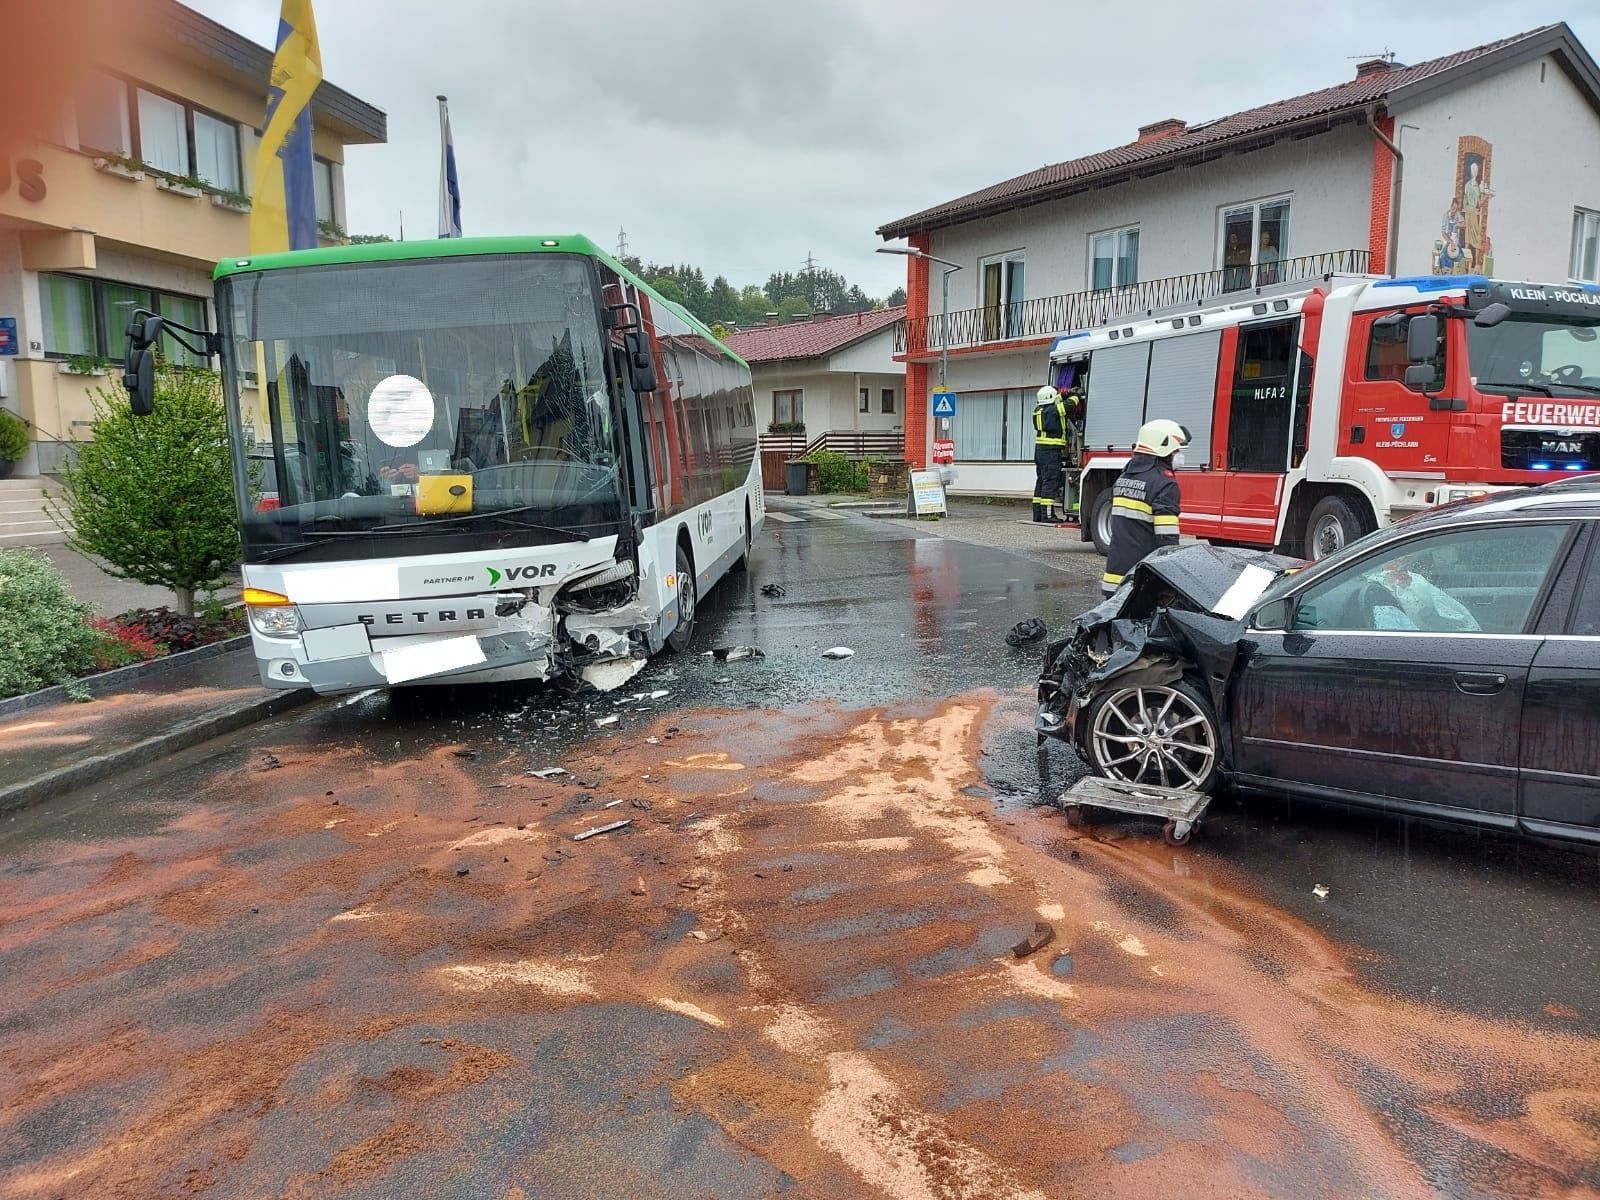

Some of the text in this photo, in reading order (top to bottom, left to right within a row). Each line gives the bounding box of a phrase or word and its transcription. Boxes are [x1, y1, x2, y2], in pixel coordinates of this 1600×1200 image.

[1511, 288, 1547, 301] KLEIN
[1554, 289, 1600, 305] PÖCHLA
[1254, 386, 1286, 400] HLFA 2
[1541, 441, 1582, 453] MAN
[423, 576, 462, 585] PARTNER
[504, 563, 557, 581] VOR
[357, 608, 486, 625] SETRA
